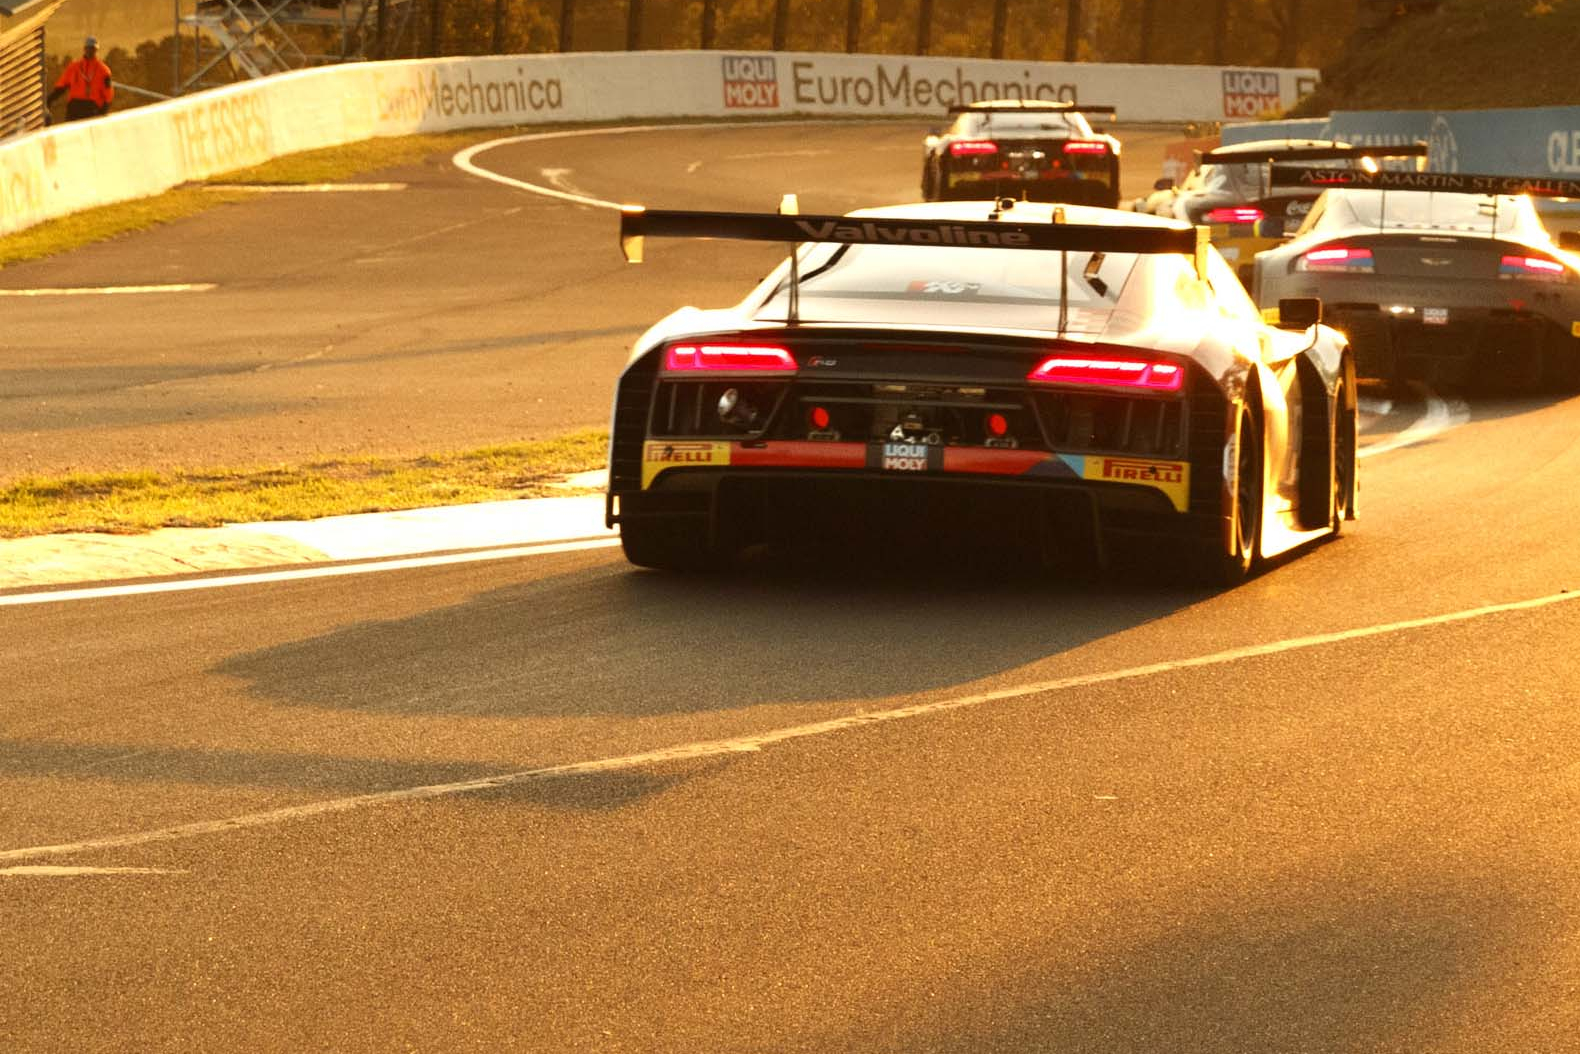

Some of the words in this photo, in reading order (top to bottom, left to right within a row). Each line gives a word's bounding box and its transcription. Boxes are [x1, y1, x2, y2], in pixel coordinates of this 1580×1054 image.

[725, 58, 774, 81] LIQUI
[726, 83, 777, 105] MOLY
[792, 62, 1078, 108] EuroMechanica
[1224, 74, 1277, 93] LIQUI
[1301, 170, 1374, 185] ASTON
[1380, 174, 1464, 188] MARTIN
[794, 220, 1033, 245] Valvoline
[885, 444, 928, 457] LIQUI
[885, 458, 927, 470] MOLY
[1102, 458, 1183, 483] PIRELLI
